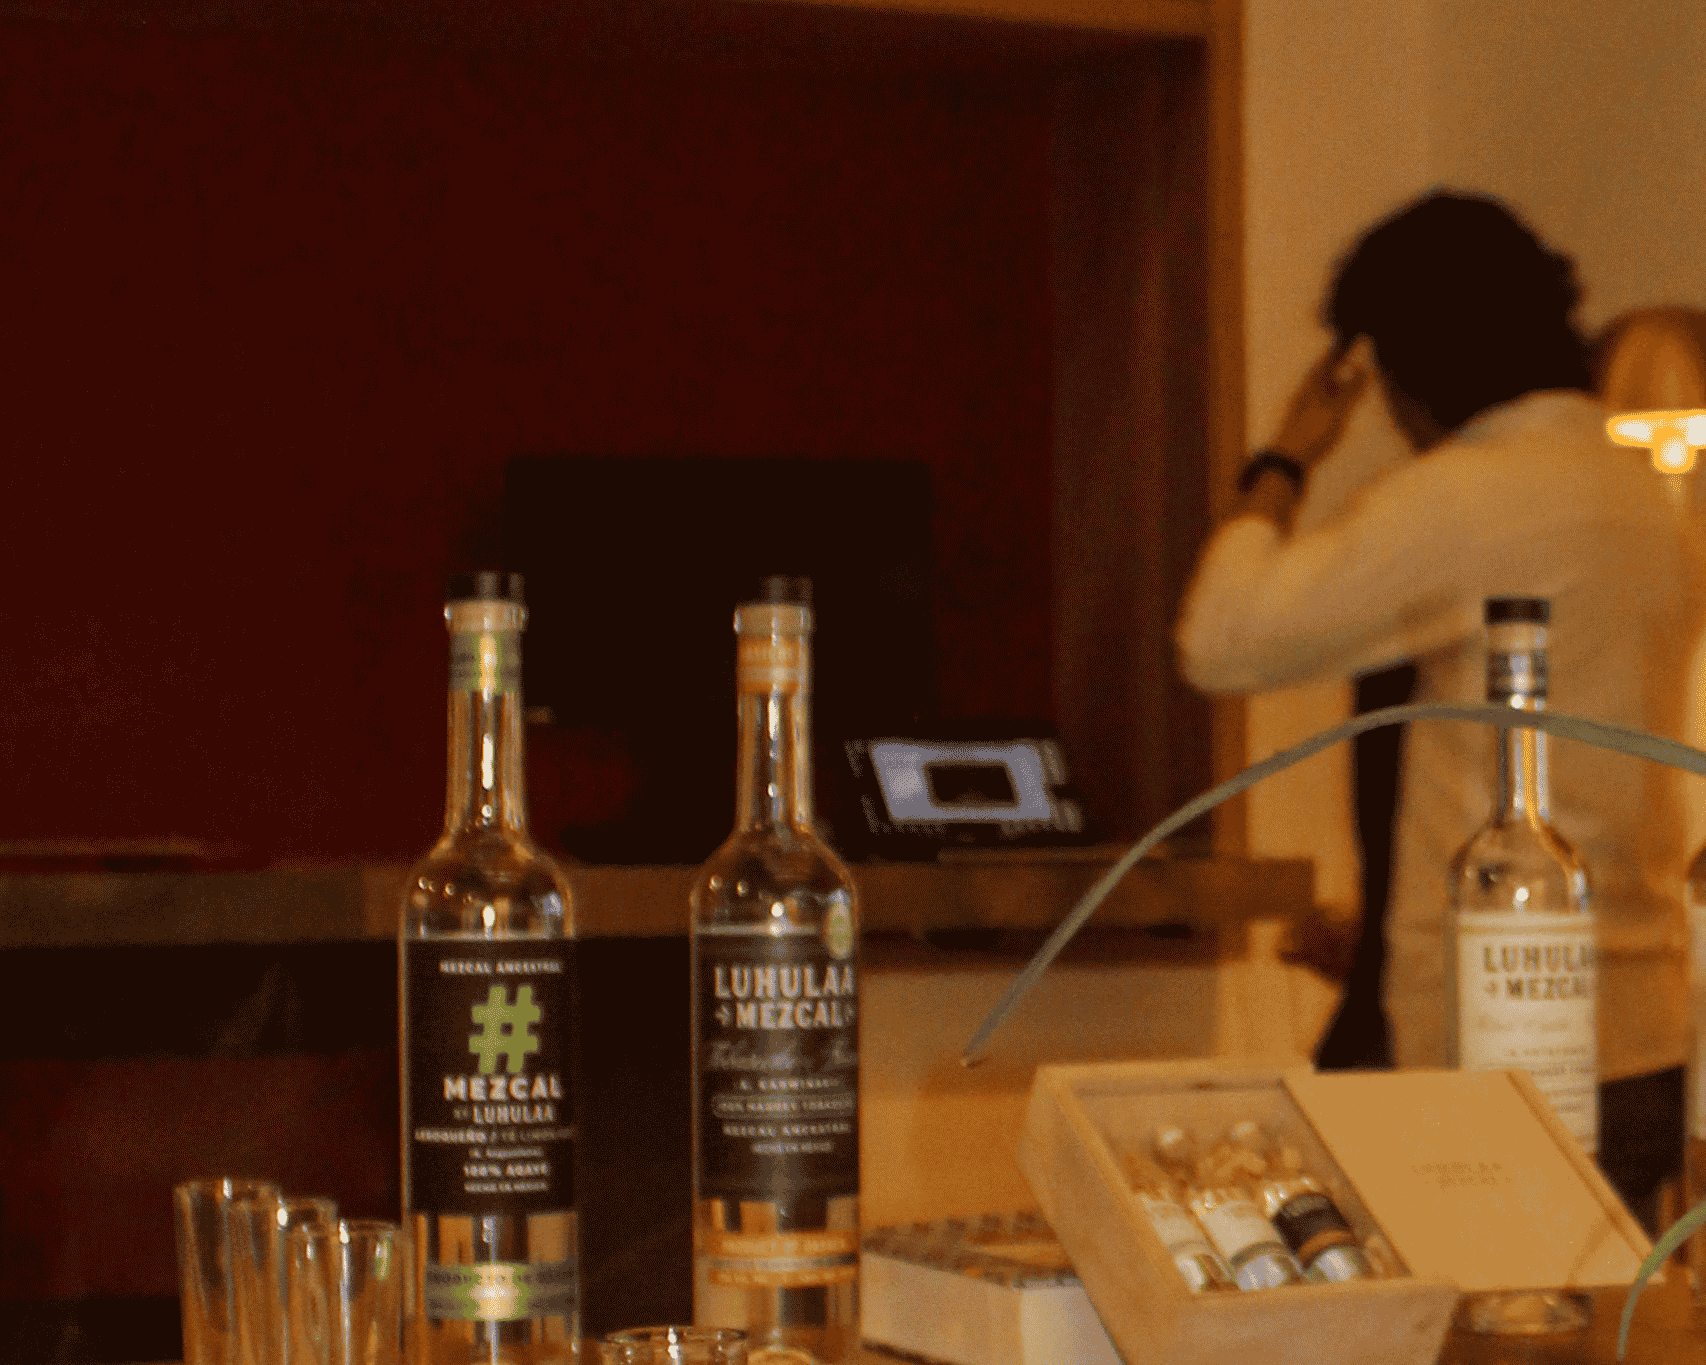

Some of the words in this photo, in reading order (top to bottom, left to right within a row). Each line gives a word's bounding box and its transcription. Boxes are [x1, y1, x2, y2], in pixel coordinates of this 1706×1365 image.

[714, 965, 854, 998] LUHULAA
[736, 1001, 843, 1029] MEZCAL
[443, 1076, 562, 1101] MEZCAL
